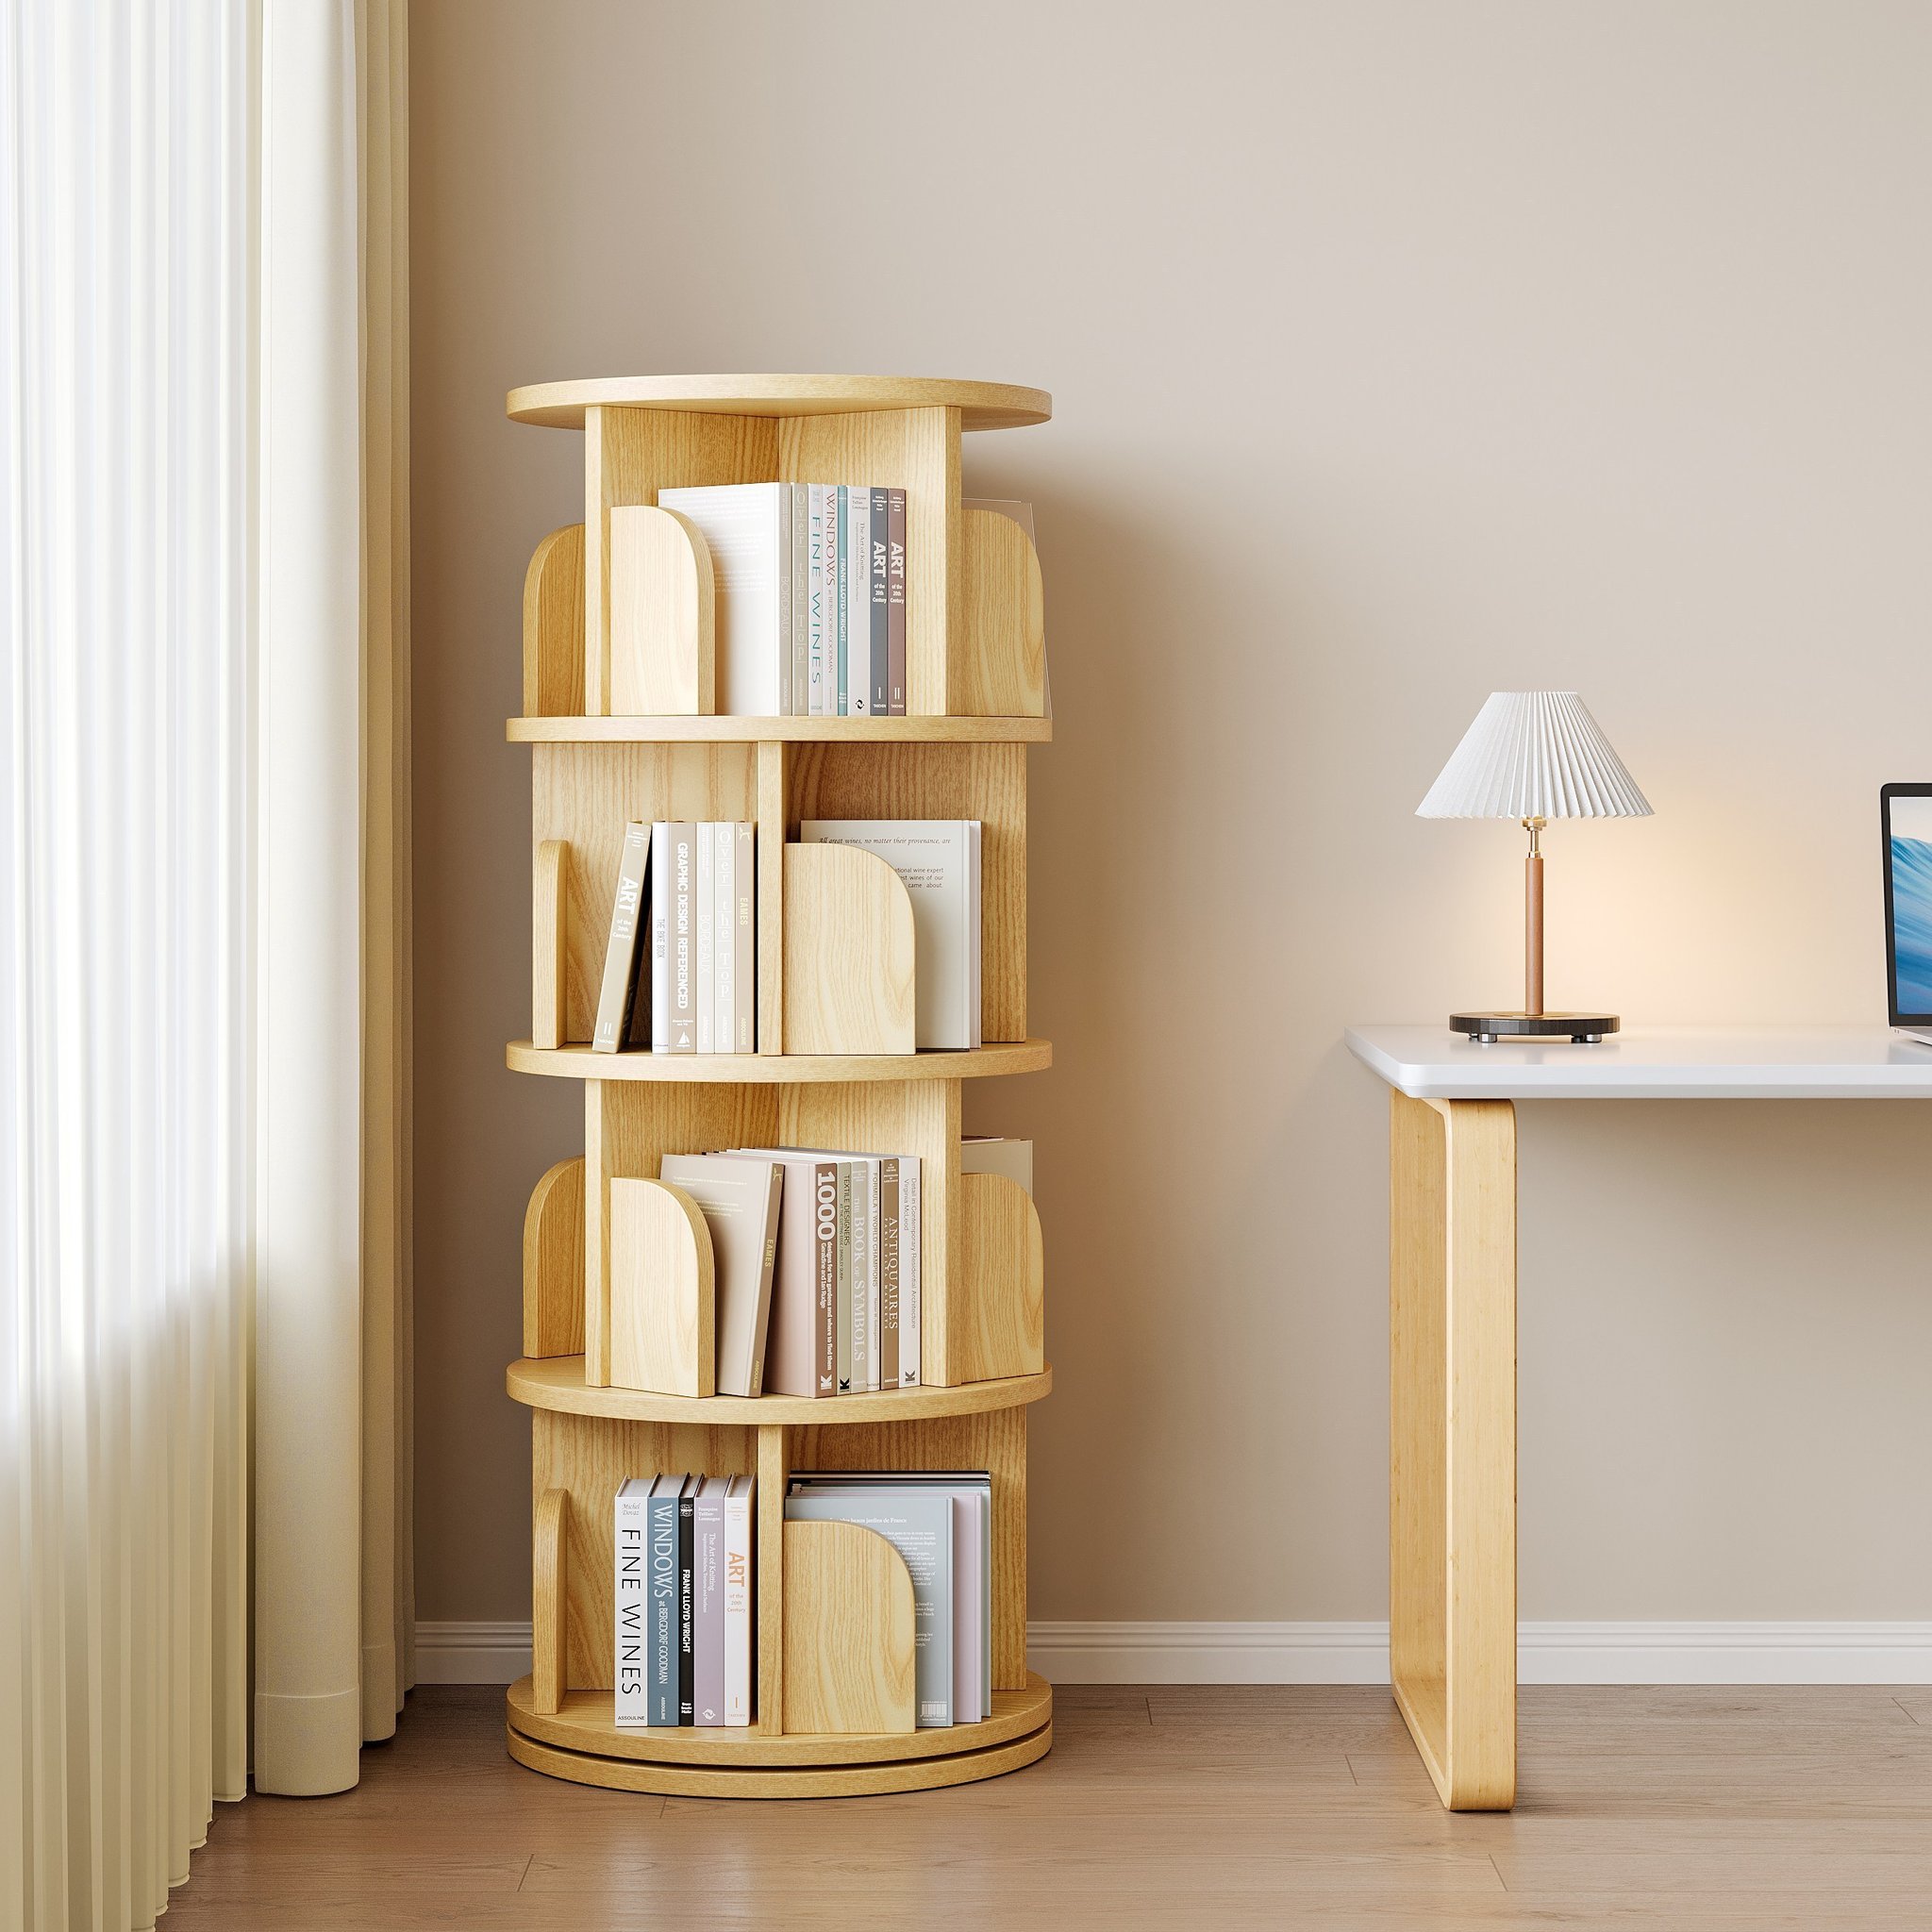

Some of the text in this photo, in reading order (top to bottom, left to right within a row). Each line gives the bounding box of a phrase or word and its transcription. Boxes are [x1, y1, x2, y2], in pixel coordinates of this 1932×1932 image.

[796, 491, 807, 546] Over
[826, 492, 836, 586] WINDOWS
[797, 561, 806, 600] the
[874, 541, 887, 577] ART
[891, 541, 904, 578] ART
[780, 575, 790, 635] BORDEAUX
[812, 516, 821, 683] FINE WINES
[677, 842, 689, 891] GRAPHIC
[720, 830, 731, 883] Over
[618, 876, 639, 915] ART
[677, 894, 689, 934] DESIGN
[721, 898, 729, 938] the
[740, 897, 749, 925] EAMES
[612, 931, 632, 941] Century
[657, 919, 666, 958] THE BIKE BOOK
[699, 915, 710, 974] BORDEAUX
[677, 937, 689, 1008] REFERENCED
[817, 1171, 836, 1241] 1000
[908, 1206, 917, 1252] Contemporary
[764, 1239, 774, 1267] EAMES
[854, 1216, 865, 1263] BOOK
[854, 1266, 859, 1276] OF
[887, 1217, 898, 1329] ANTIQUAIRES
[854, 1280, 865, 1361] SYMBOLS
[654, 1504, 673, 1598] WINDOWS
[728, 1551, 745, 1588] ART
[708, 1565, 716, 1591] Knitting
[622, 1529, 641, 1694] FINE WINES
[658, 1607, 668, 1644] BERGDORF
[682, 1569, 691, 1653] FRANK LLOYD WRIGHT
[658, 1645, 668, 1684] GOODMAN
